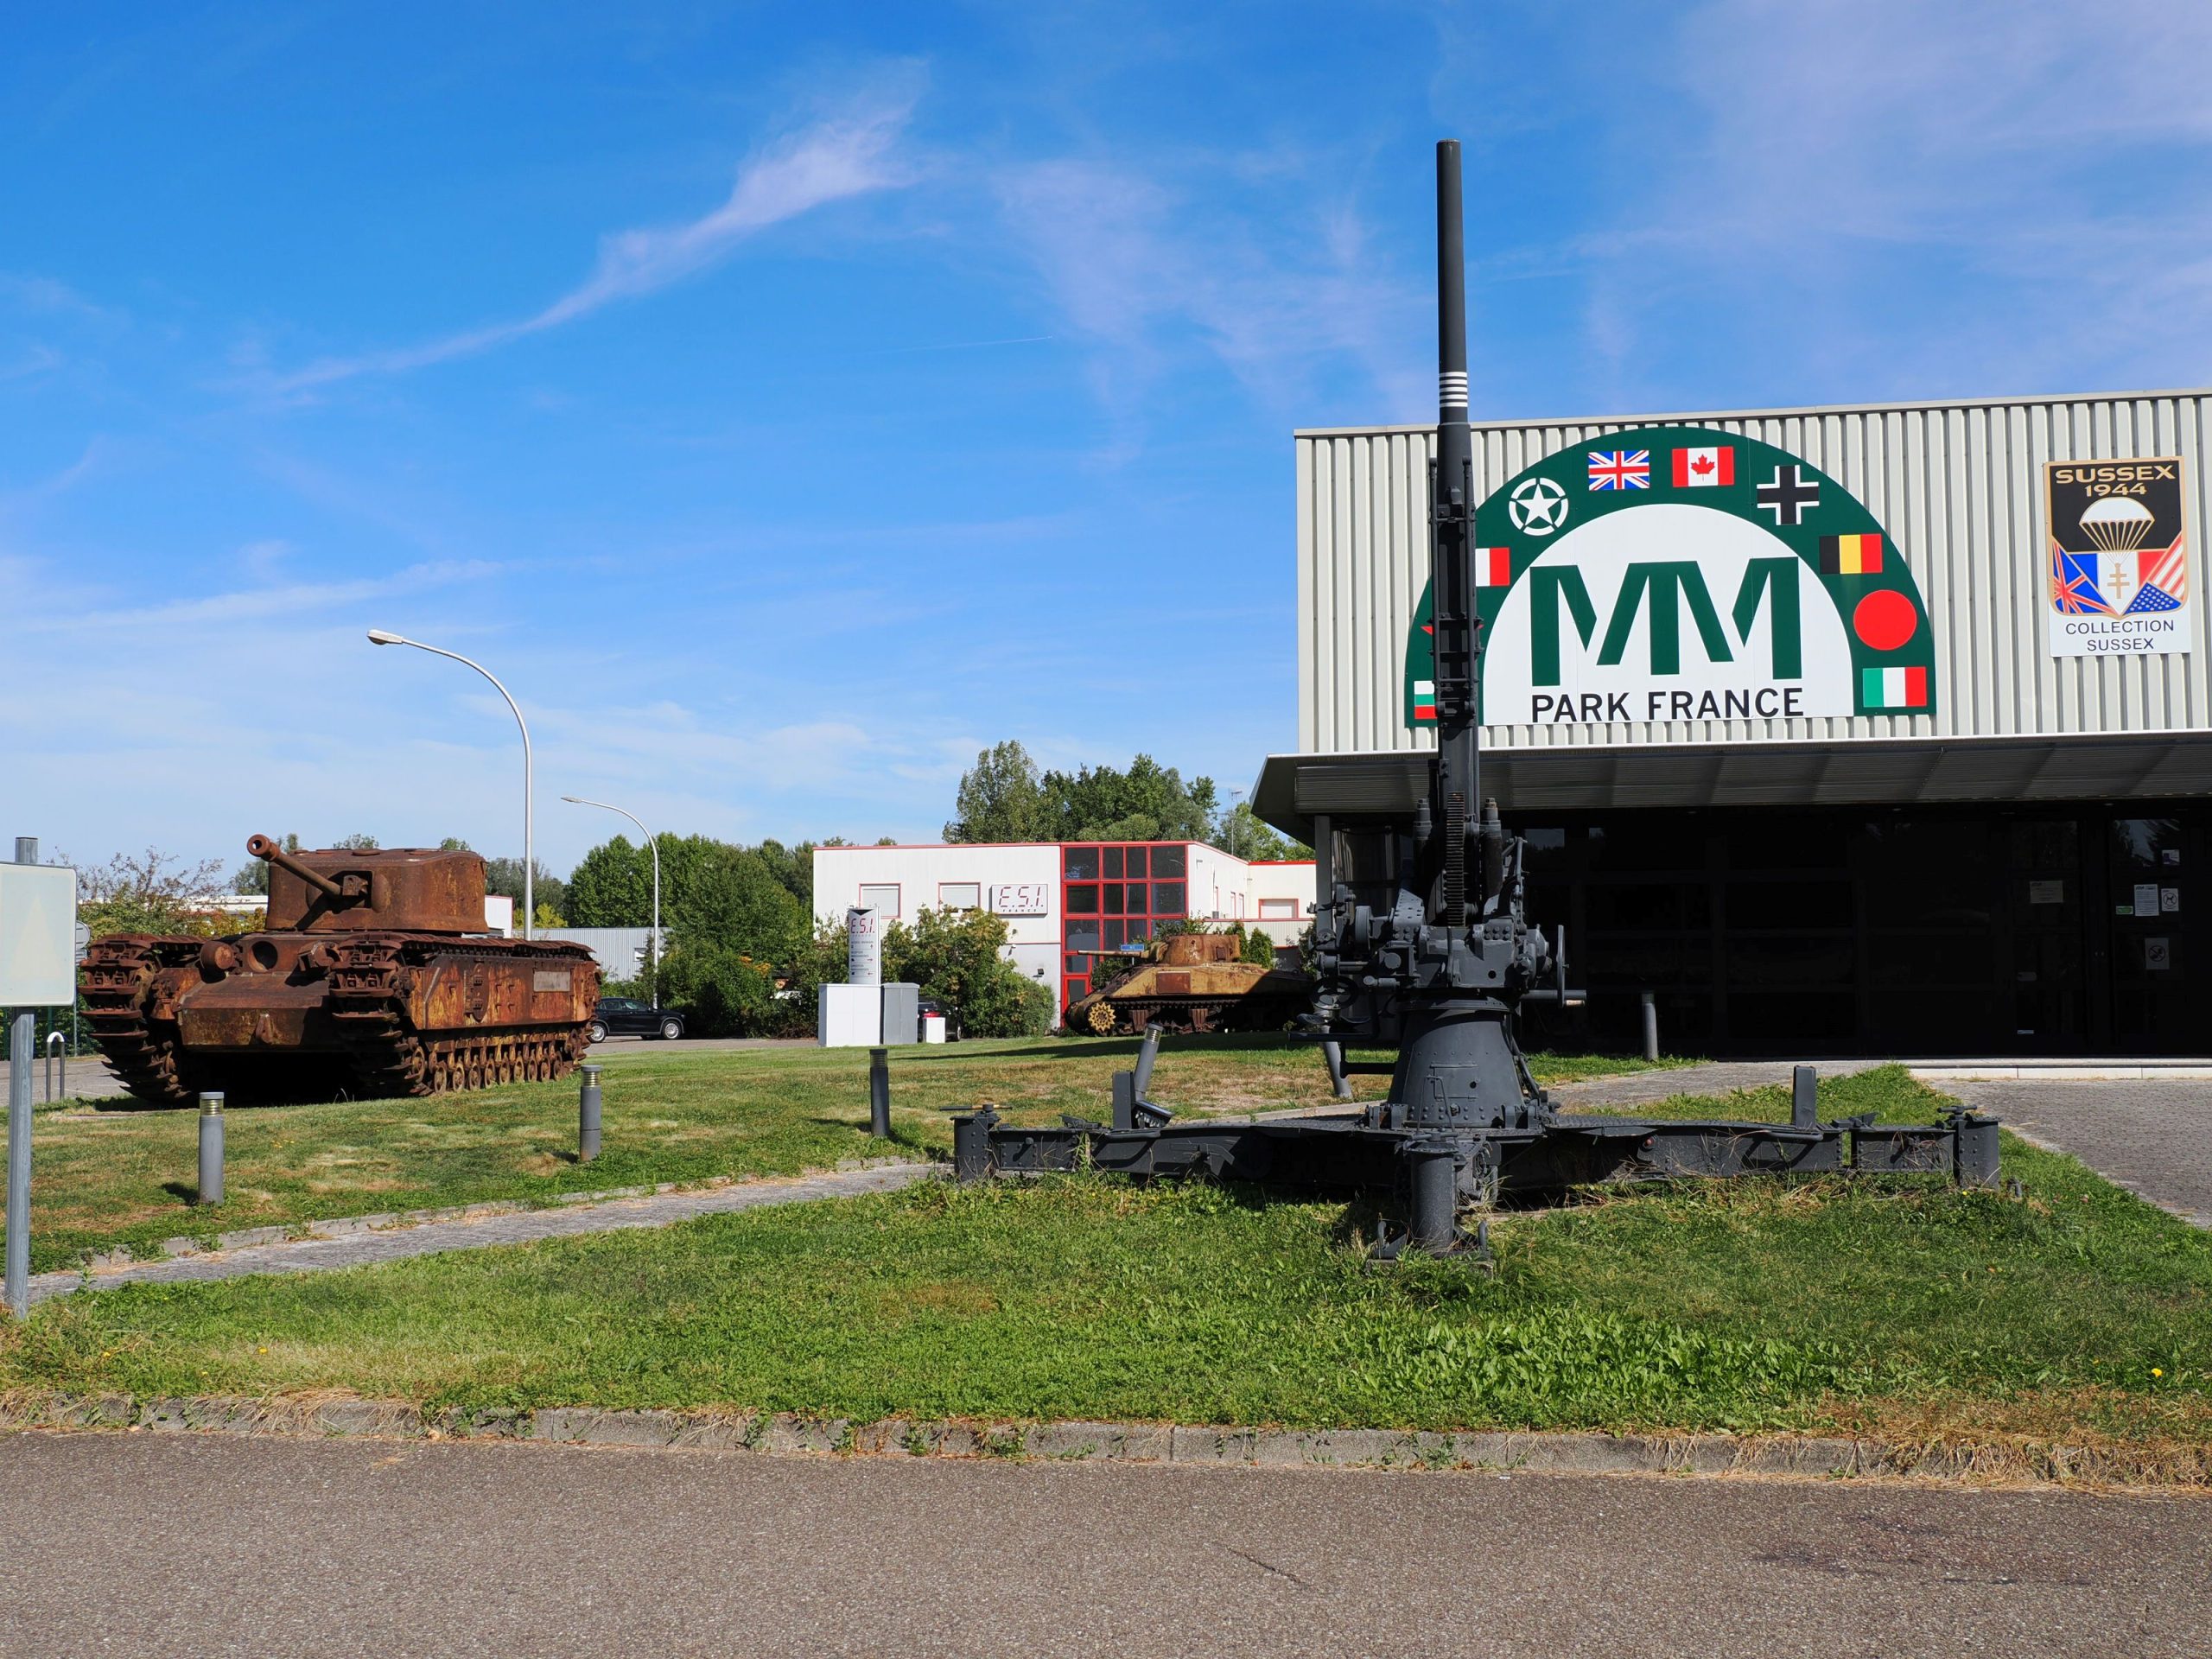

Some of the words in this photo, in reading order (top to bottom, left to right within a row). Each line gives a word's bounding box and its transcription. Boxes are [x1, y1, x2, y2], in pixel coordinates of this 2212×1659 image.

[2055, 465, 2177, 484] SUSSEX
[2085, 482, 2147, 497] 1944
[2065, 620, 2175, 635] COLLECTION
[2087, 638, 2155, 652] SUSSEX
[1531, 692, 1631, 723] PARK
[1647, 687, 1805, 720] FRANCE
